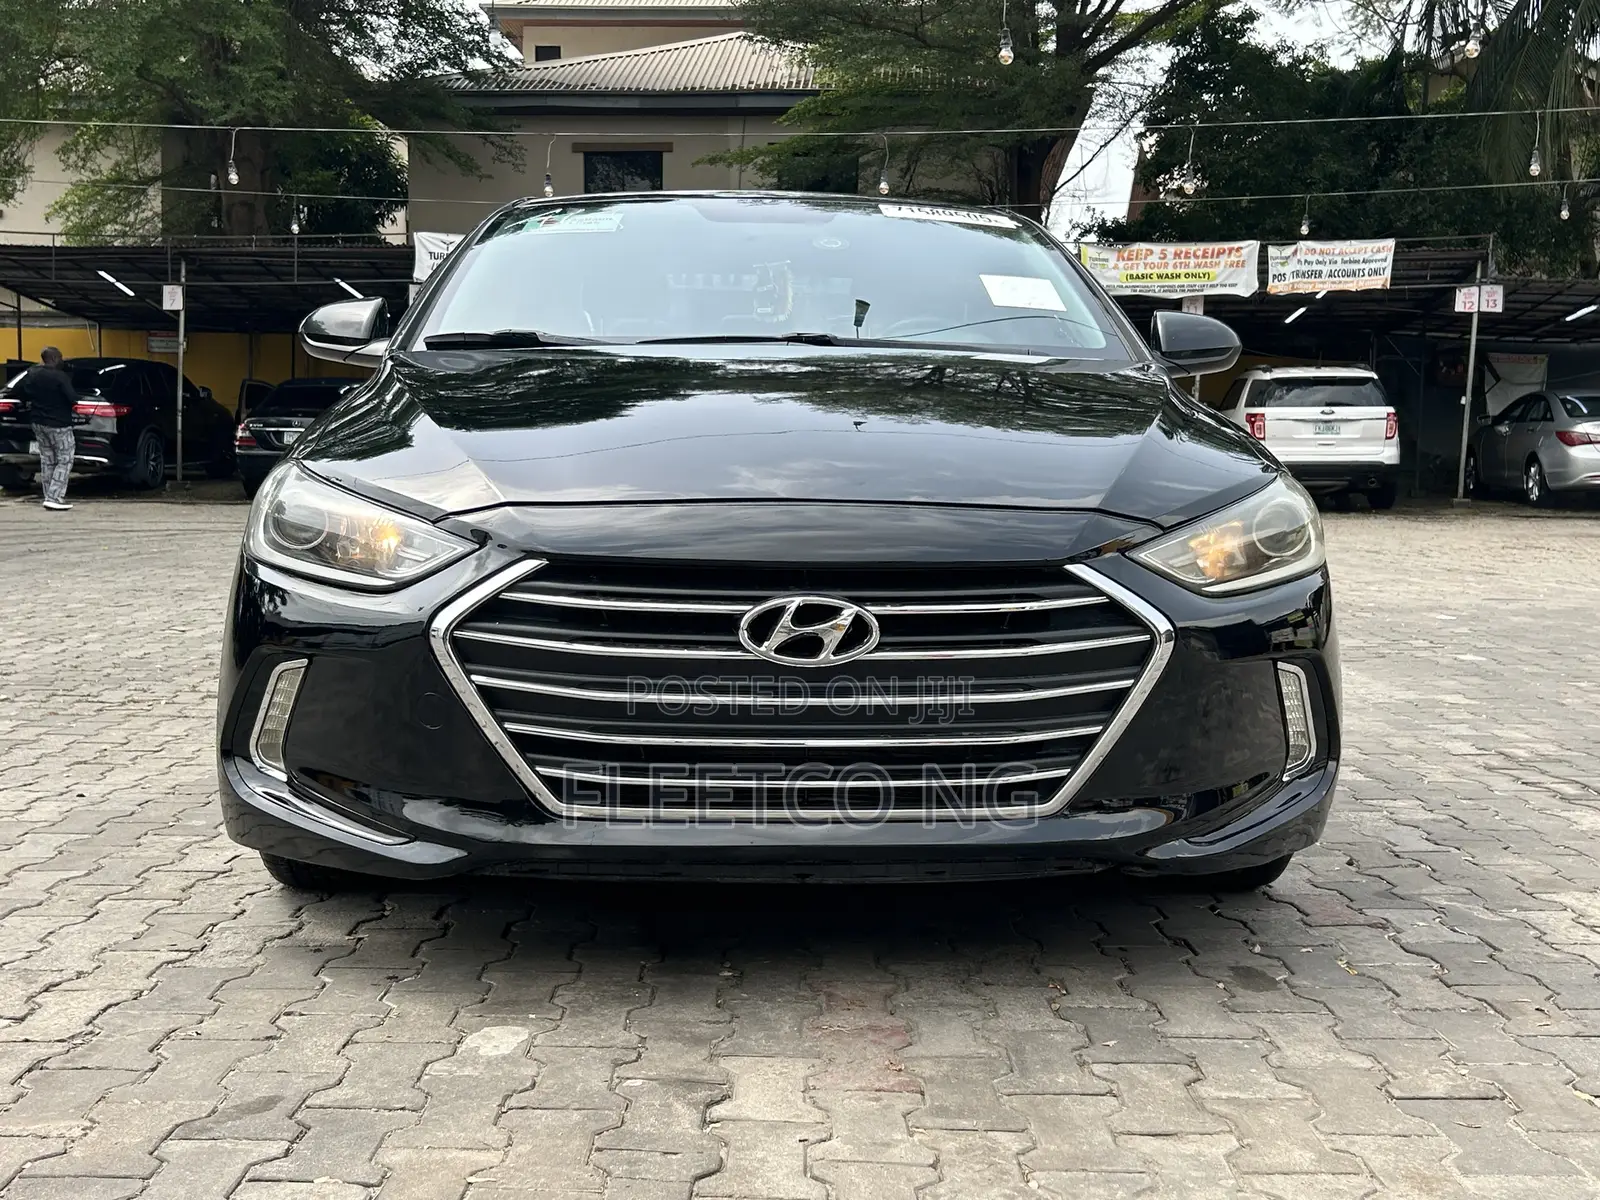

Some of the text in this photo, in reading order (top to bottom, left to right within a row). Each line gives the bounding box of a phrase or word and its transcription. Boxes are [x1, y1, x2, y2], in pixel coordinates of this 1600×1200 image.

[1116, 246, 1243, 262] KEEP 5 RECEIPTS
[1304, 248, 1316, 256] DO
[1319, 247, 1335, 256] NOT
[1339, 246, 1368, 255] ACCEPT
[1371, 245, 1393, 254] CASH
[1123, 262, 1141, 271] GET
[1143, 261, 1169, 270] YOUR
[1172, 261, 1190, 269] 6TH
[1194, 260, 1221, 269] WASH
[1224, 260, 1247, 268] FREE
[1315, 258, 1327, 266] Only
[1341, 257, 1360, 265] Turbine
[1361, 255, 1388, 265] Approved
[1125, 273, 1154, 282] (BASIC
[1184, 272, 1210, 280] ONLY)
[1272, 272, 1287, 283] POS
[1368, 267, 1387, 277] ONLY
[170, 299, 176, 307] 7
[1462, 301, 1475, 310] 12
[1485, 300, 1498, 308] 13
